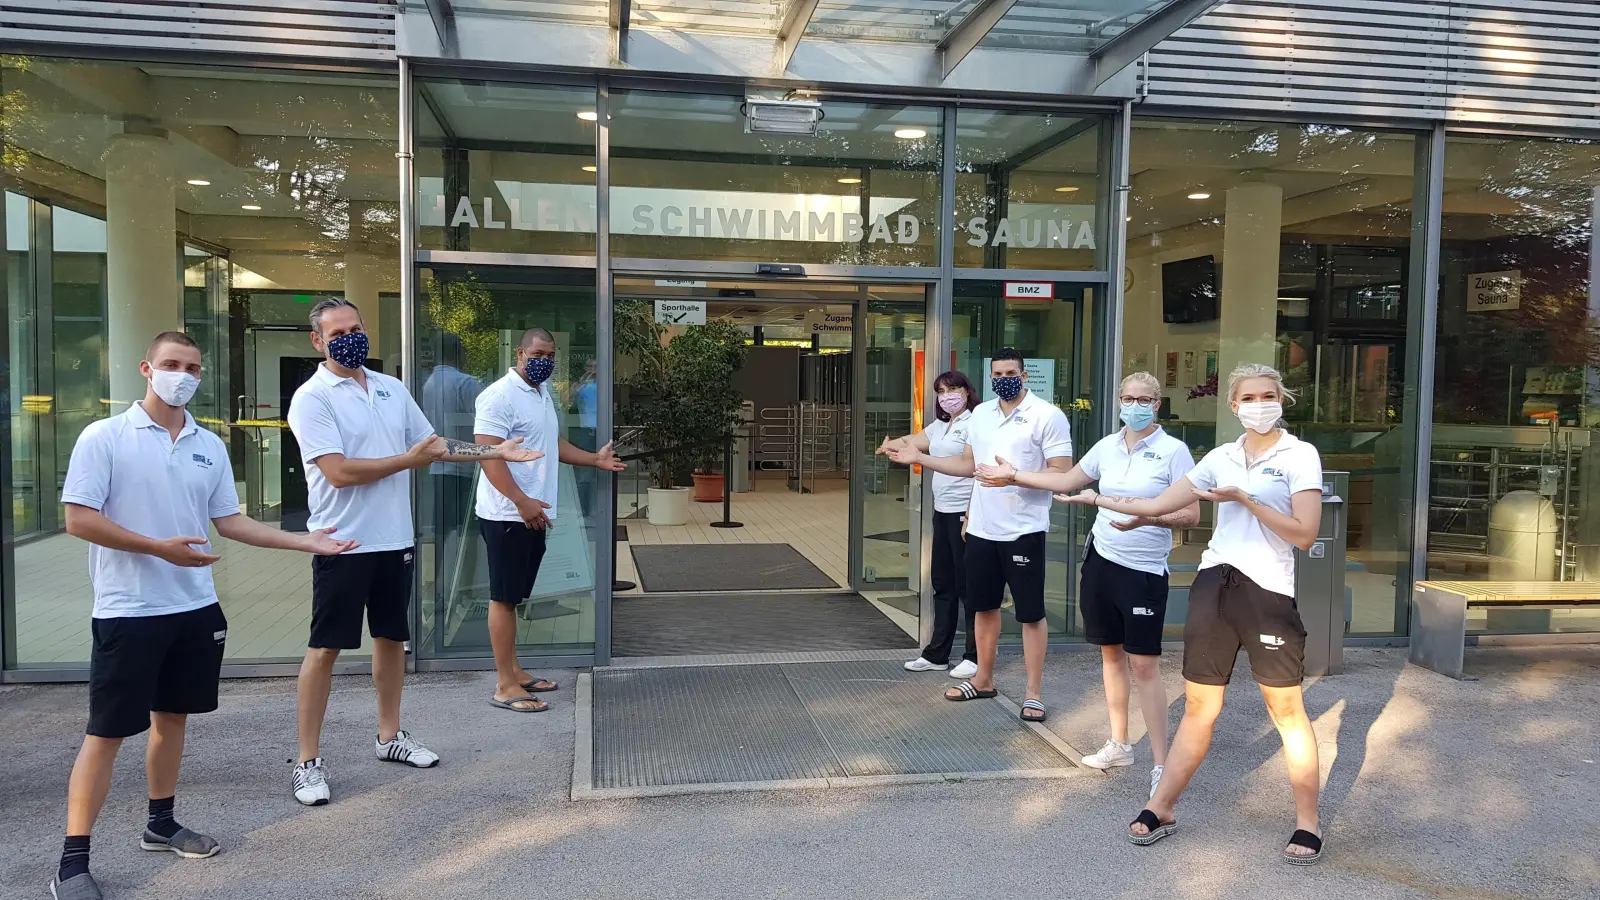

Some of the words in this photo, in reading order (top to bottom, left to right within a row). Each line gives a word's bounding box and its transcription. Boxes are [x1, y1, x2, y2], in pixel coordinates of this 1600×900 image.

[632, 204, 920, 244] SCHWIMMBAD
[967, 216, 1097, 249] SAUNA
[1017, 285, 1040, 294] BMZ
[1477, 293, 1508, 304] Sauna
[661, 303, 700, 311] Sporthalle
